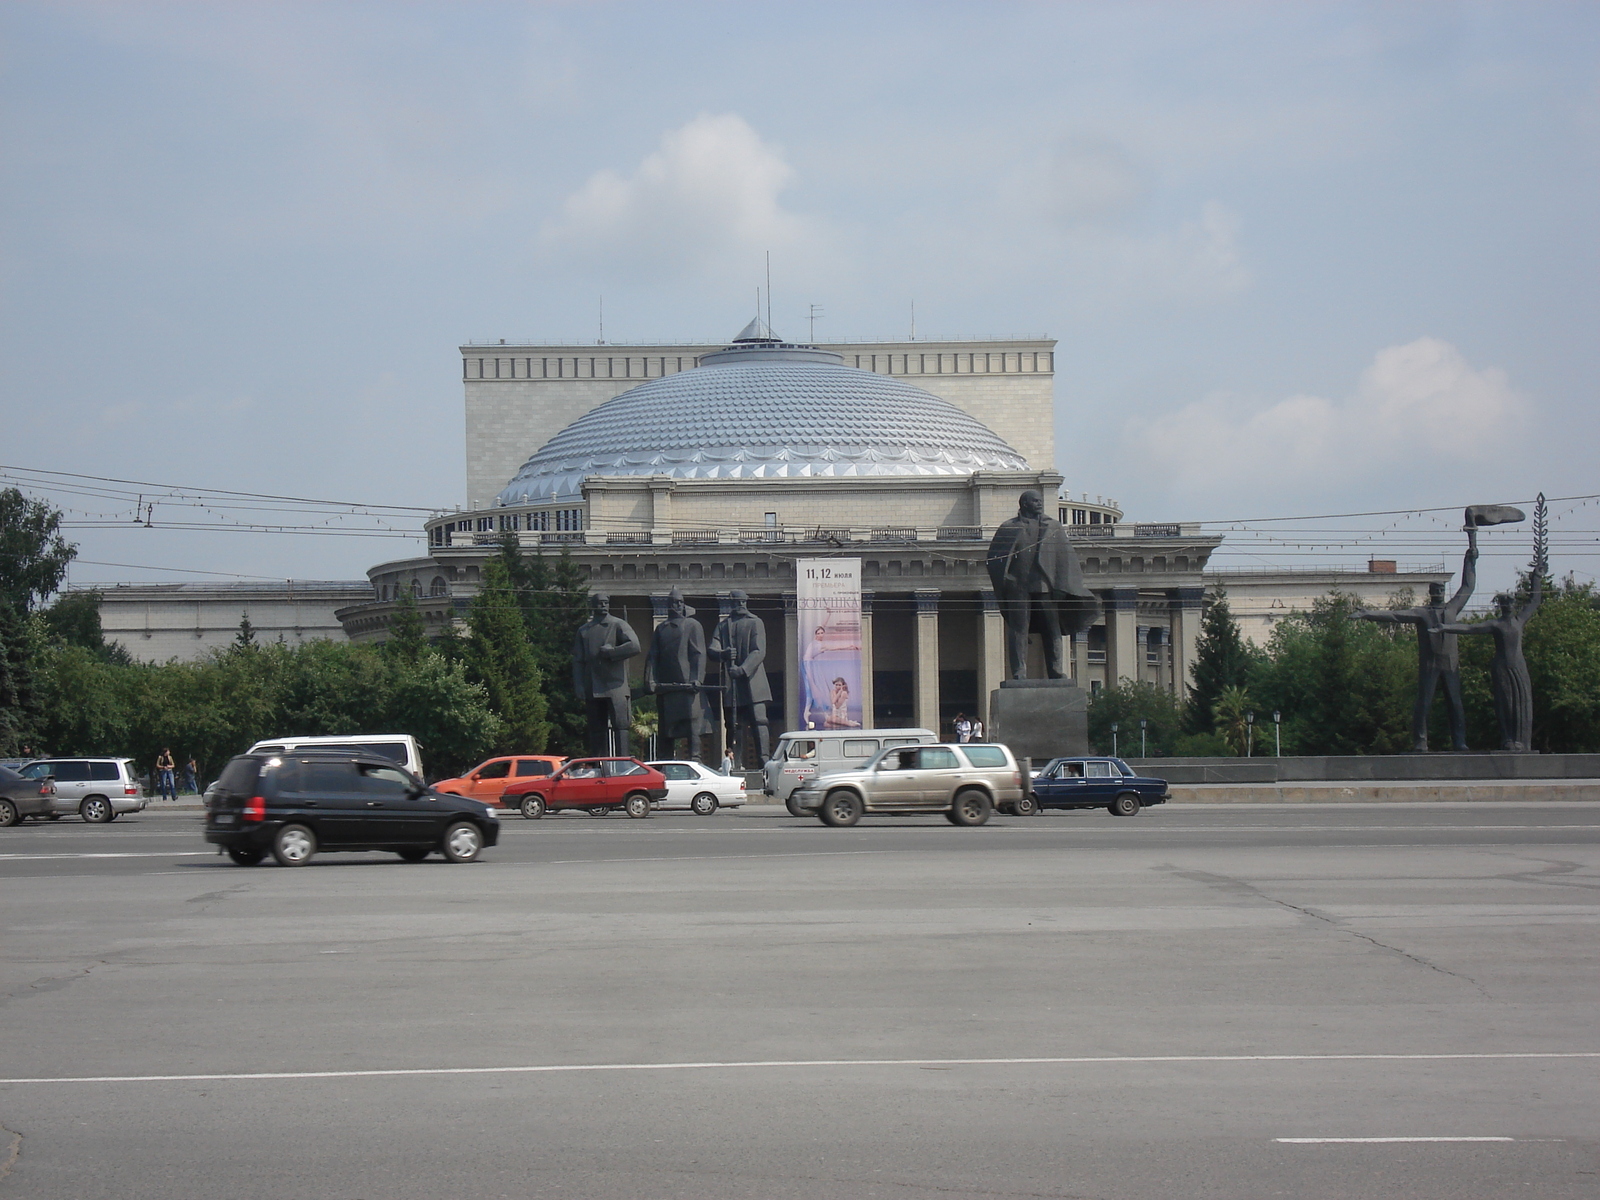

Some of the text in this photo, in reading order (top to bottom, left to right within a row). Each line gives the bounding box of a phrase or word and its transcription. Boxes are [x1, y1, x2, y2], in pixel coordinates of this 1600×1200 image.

[806, 568, 819, 580] 11,
[821, 568, 831, 579] 12
[798, 597, 859, 609] ЗОЛУШКА
